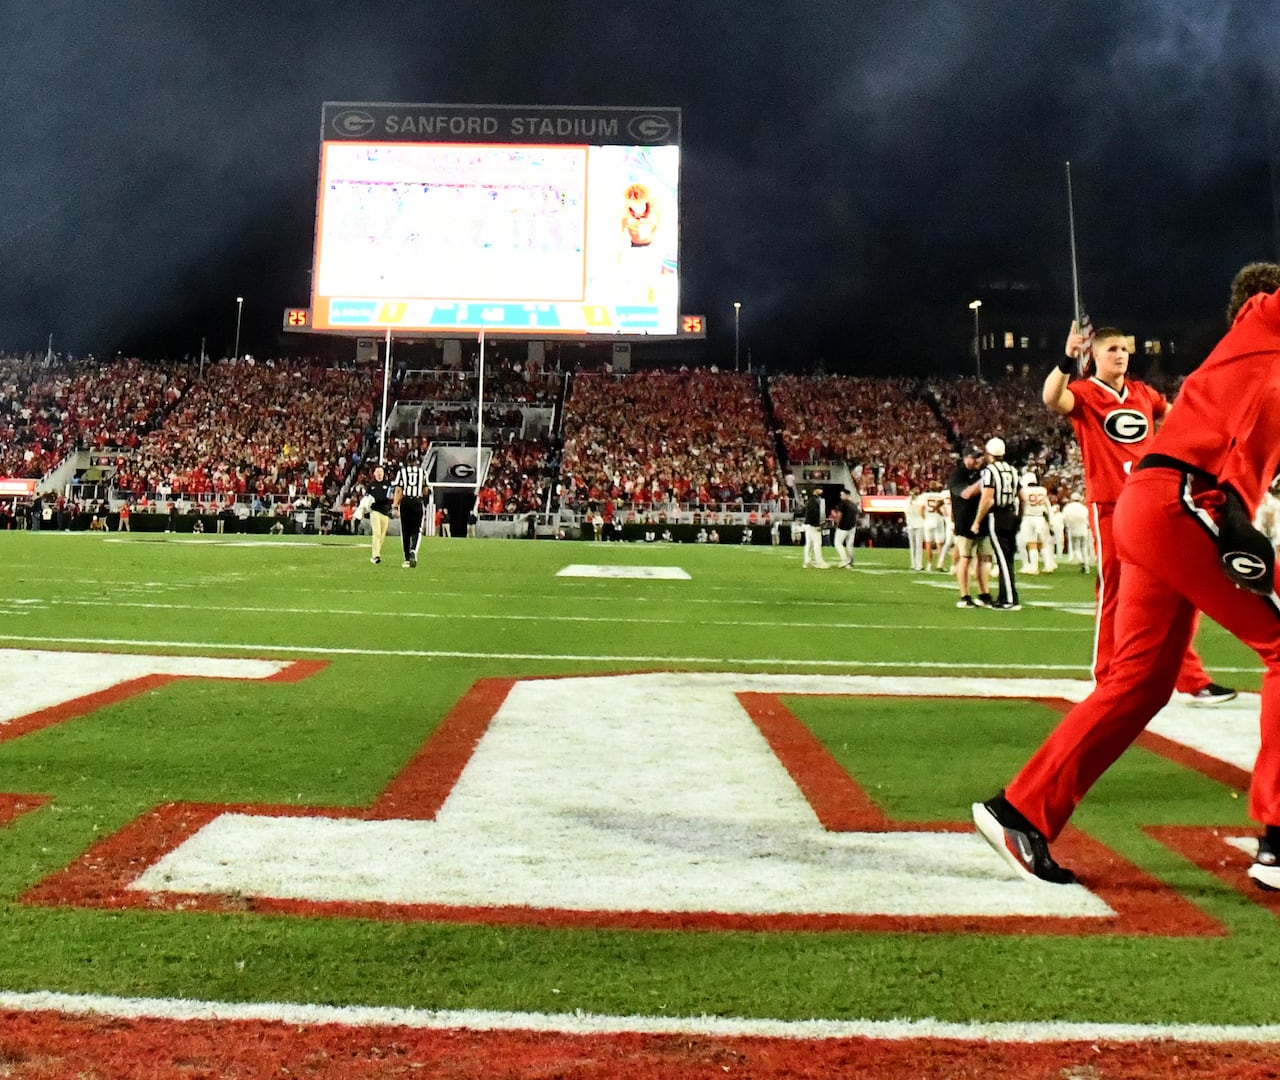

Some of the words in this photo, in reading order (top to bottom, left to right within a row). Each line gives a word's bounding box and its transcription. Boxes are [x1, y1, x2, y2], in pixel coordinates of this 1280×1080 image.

[385, 115, 498, 134] SANFORD
[511, 117, 618, 136] STADIUM
[288, 311, 306, 327] 25
[683, 316, 701, 332] 25
[1110, 412, 1148, 440] G
[408, 473, 418, 486] U
[450, 464, 476, 479] G
[1227, 554, 1266, 576] G
